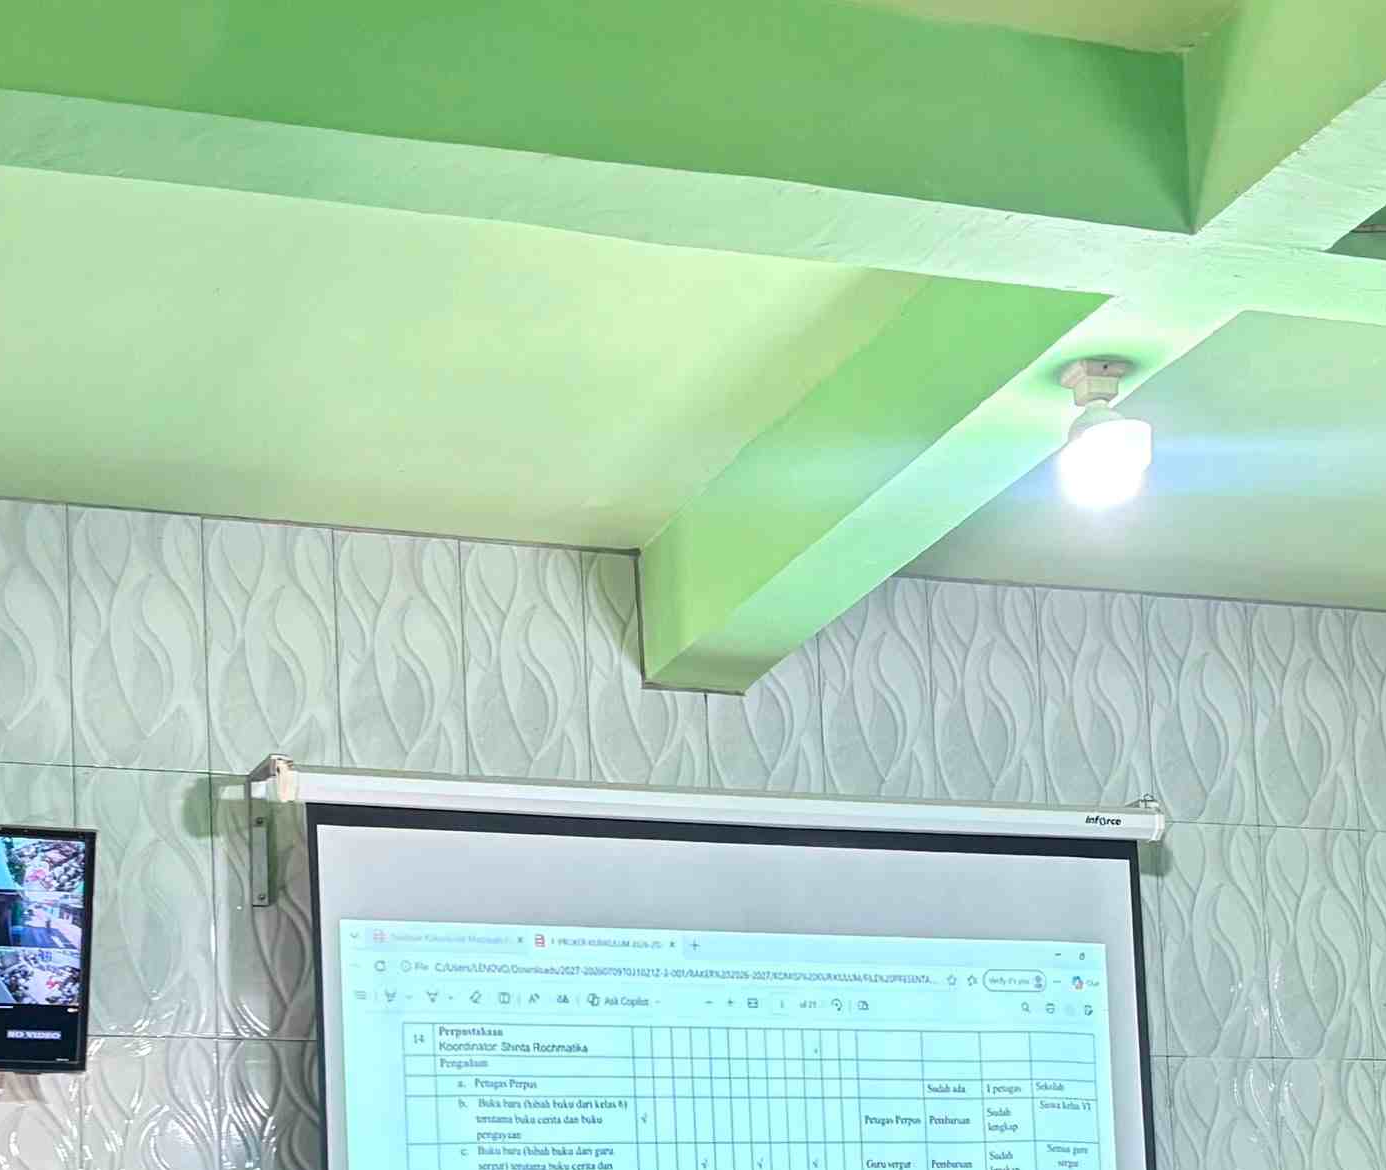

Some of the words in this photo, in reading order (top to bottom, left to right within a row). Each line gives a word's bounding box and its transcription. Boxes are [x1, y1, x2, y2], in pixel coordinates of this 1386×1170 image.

[1085, 816, 1121, 826] inforce
[605, 997, 618, 1006] Ask
[621, 996, 649, 1008] Copilot
[26, 1031, 61, 1040] VIDEO
[439, 1027, 503, 1038] Perpustakaan
[413, 1035, 425, 1043] 14
[502, 1042, 530, 1052] Shinta
[475, 1078, 507, 1091] Petugas
[509, 1079, 537, 1091] Perpus
[927, 1084, 950, 1093] Sudah
[952, 1085, 965, 1093] ada
[1036, 1082, 1064, 1091] Sekolah
[993, 1085, 1021, 1095] petugas
[478, 1099, 500, 1108] Buku
[503, 1100, 521, 1108] baru
[553, 1100, 574, 1108] buku
[576, 1100, 593, 1108] dari
[594, 1100, 616, 1108] kelas
[987, 1108, 1010, 1117] Sudah
[515, 1115, 535, 1124] buku
[538, 1116, 561, 1124] cerita
[564, 1115, 579, 1124] dan
[581, 1115, 603, 1124] buku
[865, 1116, 893, 1126] Petugas
[896, 1116, 921, 1126] Perpus
[988, 1122, 1018, 1133] lengkap
[478, 1147, 500, 1156] Buku
[503, 1147, 521, 1156] baru
[552, 1147, 574, 1156] buku
[595, 1148, 614, 1158] guru
[989, 1151, 1013, 1161] Sudah
[549, 1162, 570, 1170] buku
[572, 1162, 595, 1170] cerita
[598, 1162, 613, 1170] dan
[866, 1160, 886, 1169] Guru
